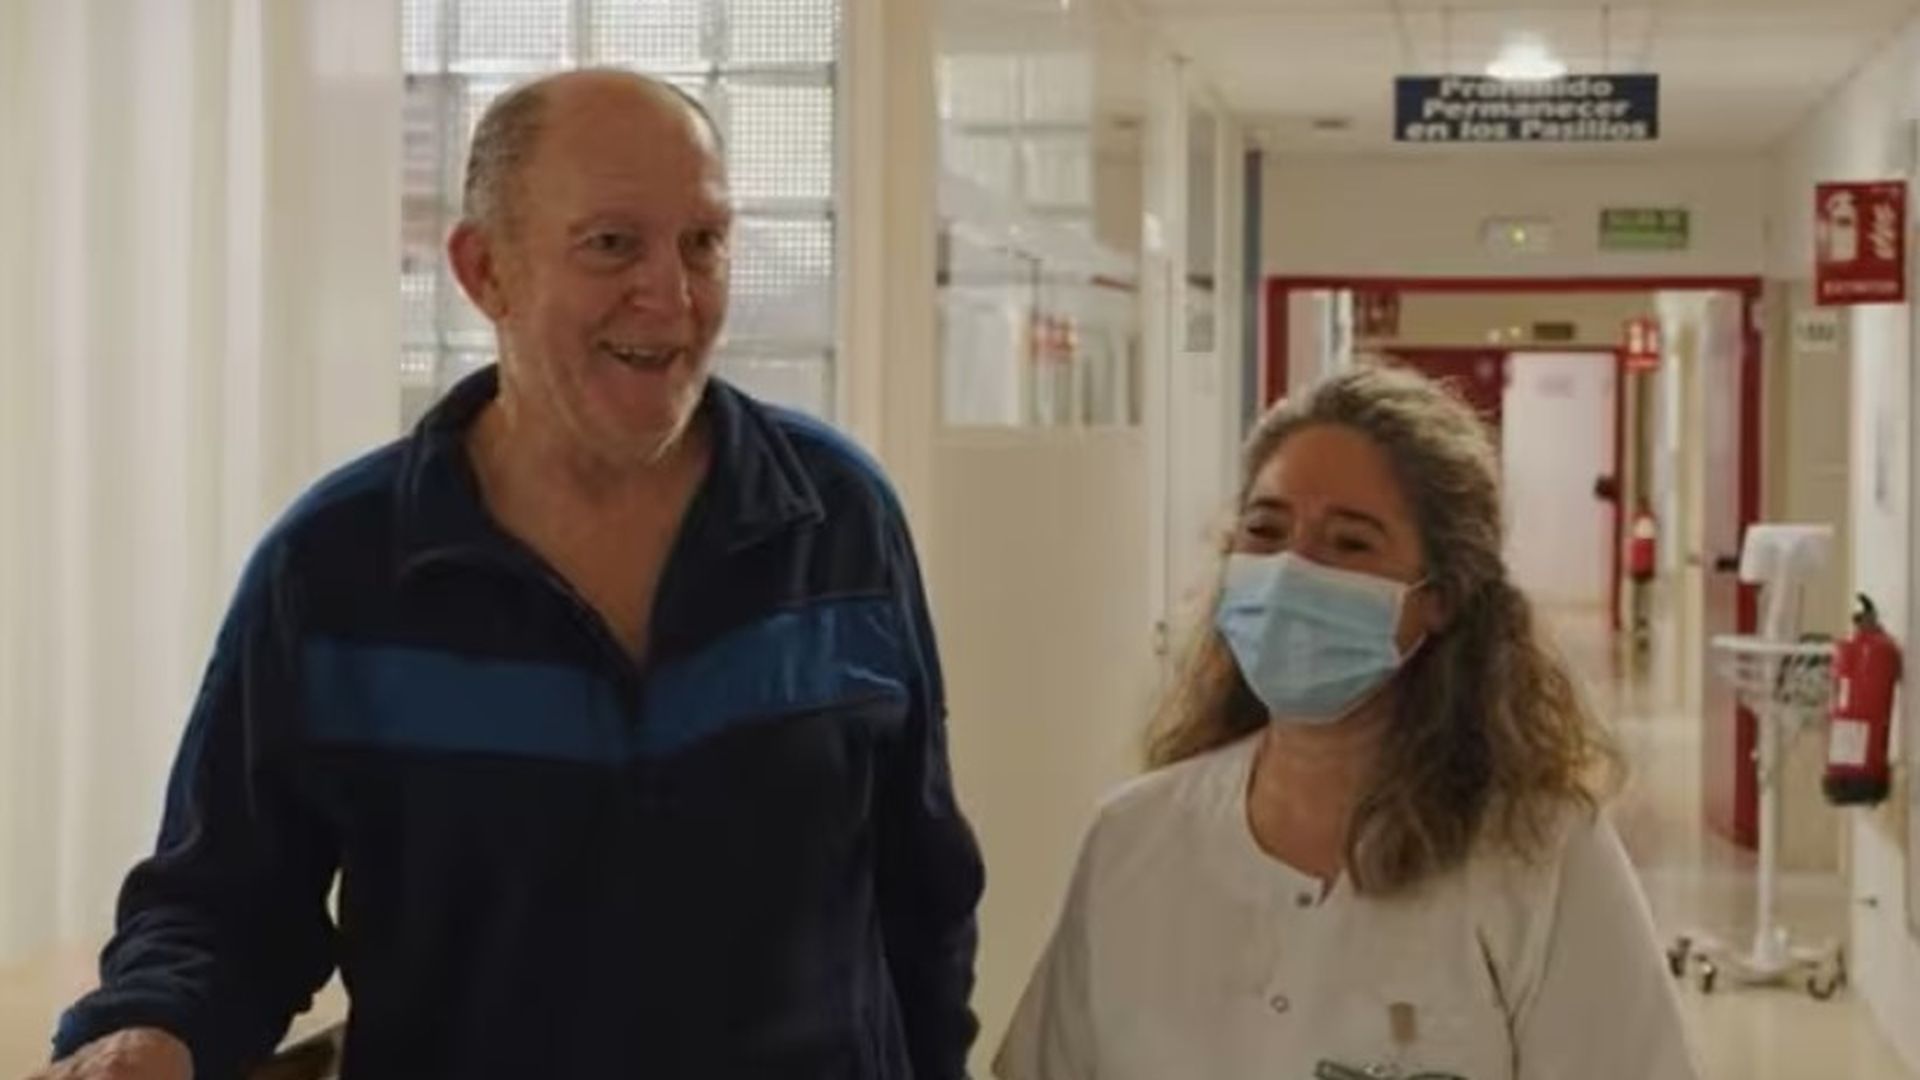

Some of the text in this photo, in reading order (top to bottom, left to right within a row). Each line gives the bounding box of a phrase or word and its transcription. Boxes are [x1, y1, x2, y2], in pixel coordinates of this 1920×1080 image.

[1422, 99, 1632, 119] Permanecer
[1405, 119, 1649, 140] en los Pasillos
